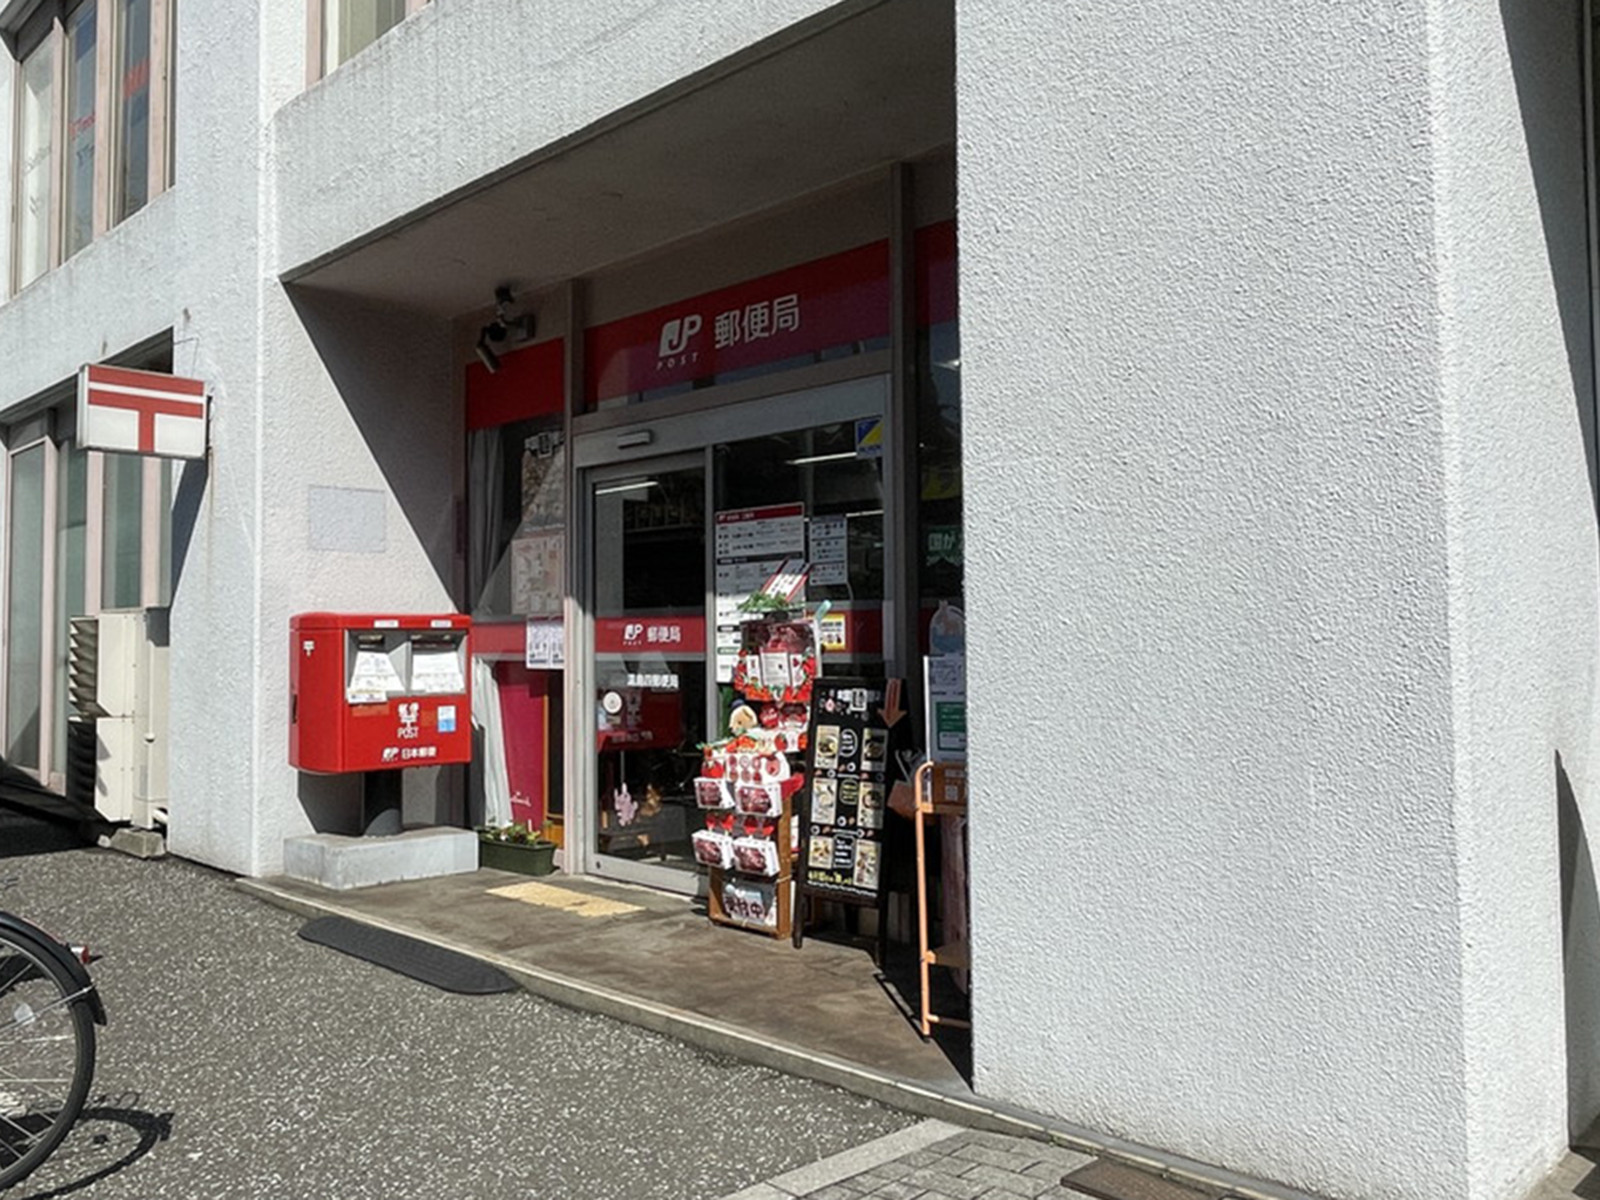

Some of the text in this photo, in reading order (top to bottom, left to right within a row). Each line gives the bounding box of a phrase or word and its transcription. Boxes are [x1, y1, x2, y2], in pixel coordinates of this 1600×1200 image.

[658, 293, 800, 358] JP 郵便局
[656, 352, 699, 371] POST
[647, 625, 681, 643] 郵便局
[397, 727, 419, 739] POST
